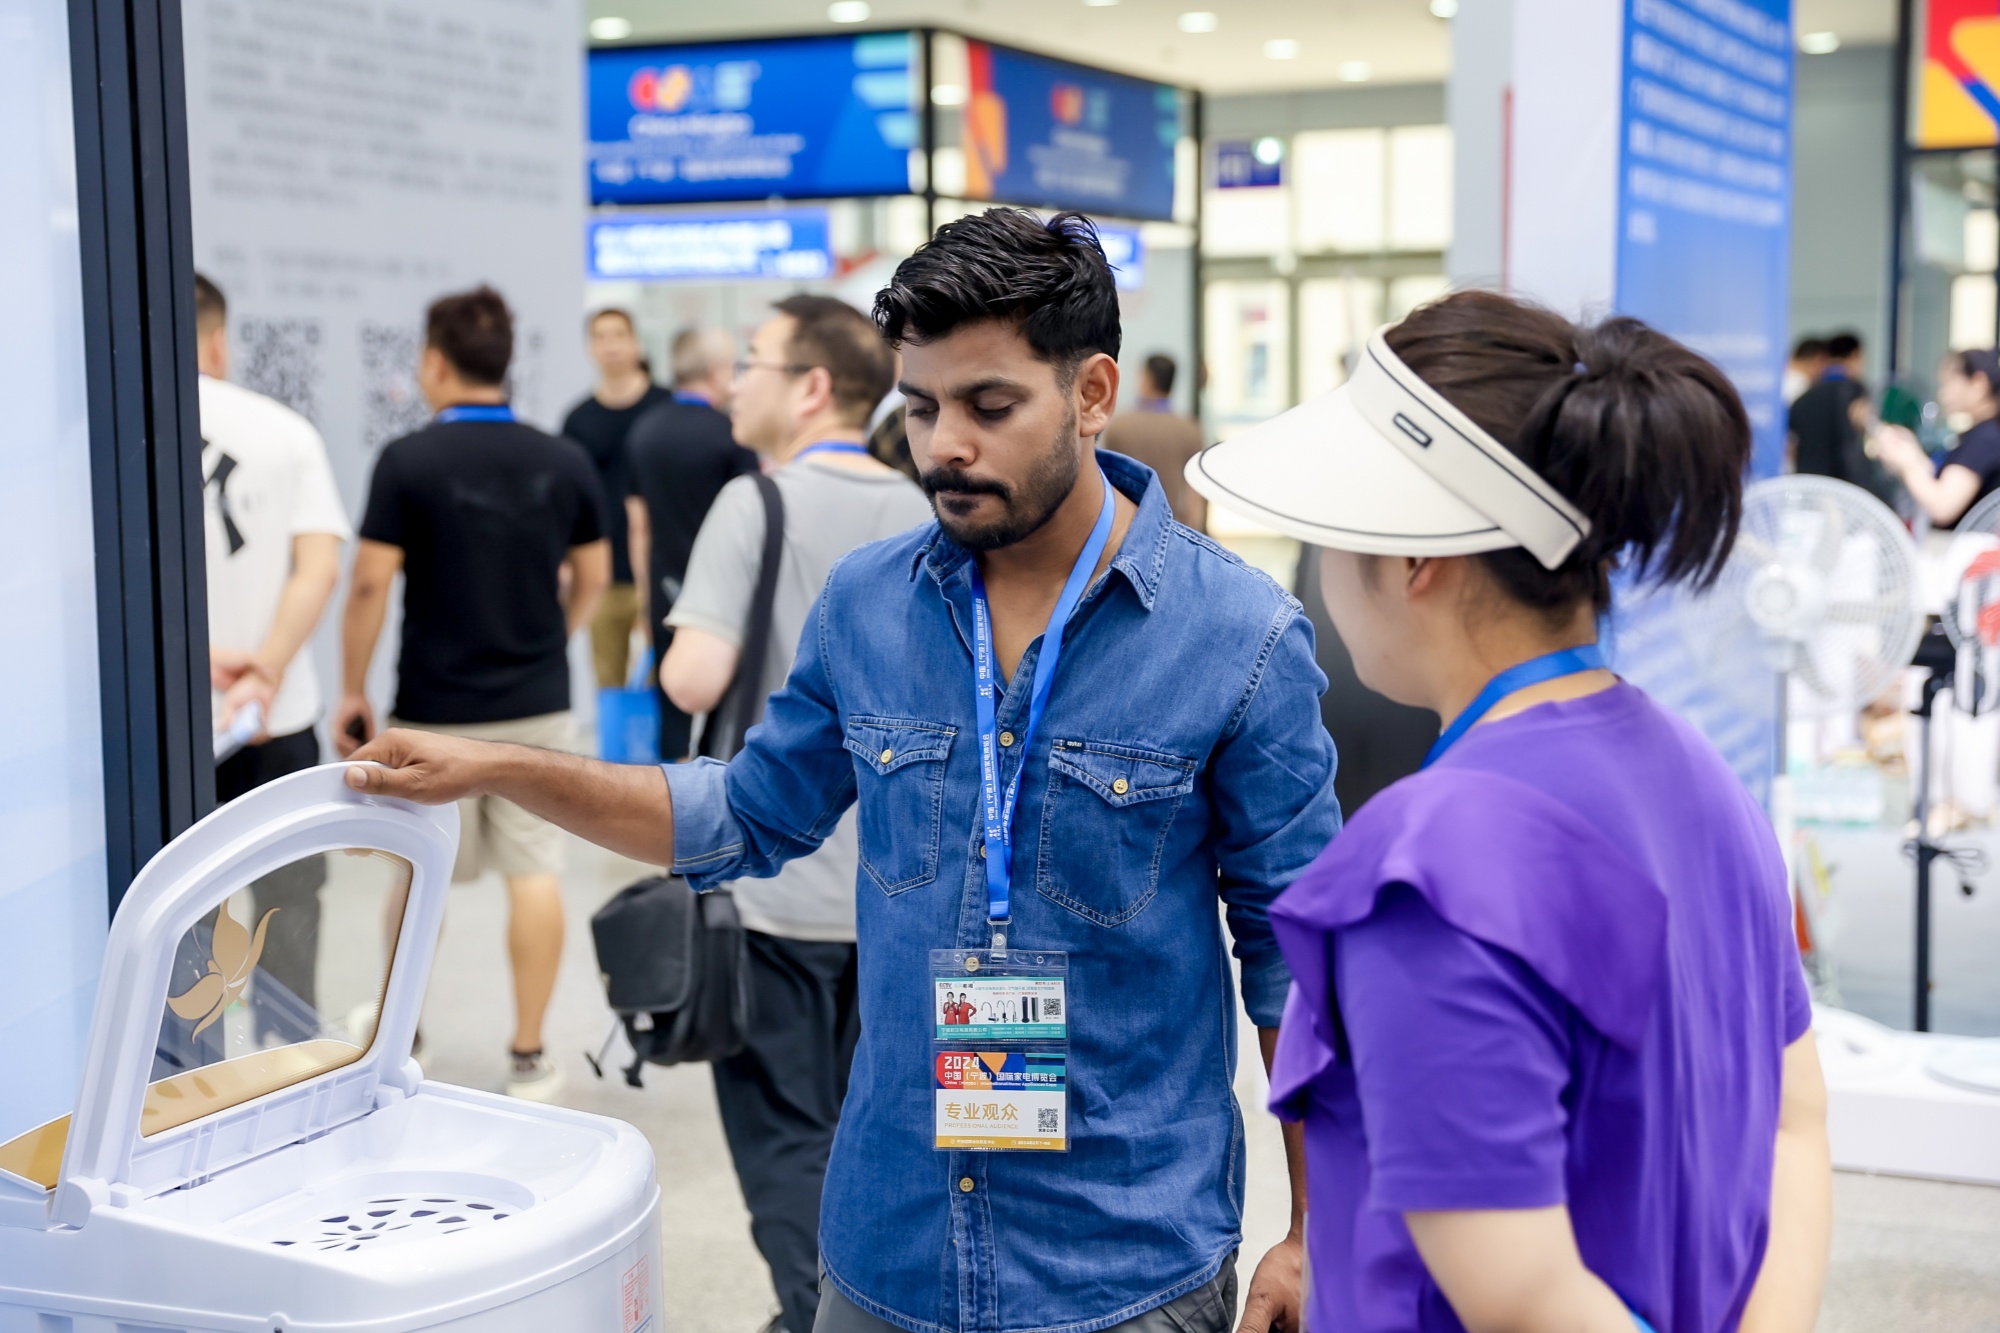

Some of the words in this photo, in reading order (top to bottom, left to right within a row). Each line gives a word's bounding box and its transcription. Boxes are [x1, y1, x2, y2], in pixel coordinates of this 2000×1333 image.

[944, 1056, 980, 1069] 2024
[944, 1071, 1057, 1082] 中国（宁波）国际家电博览会
[945, 1102, 1018, 1121] 专业观众
